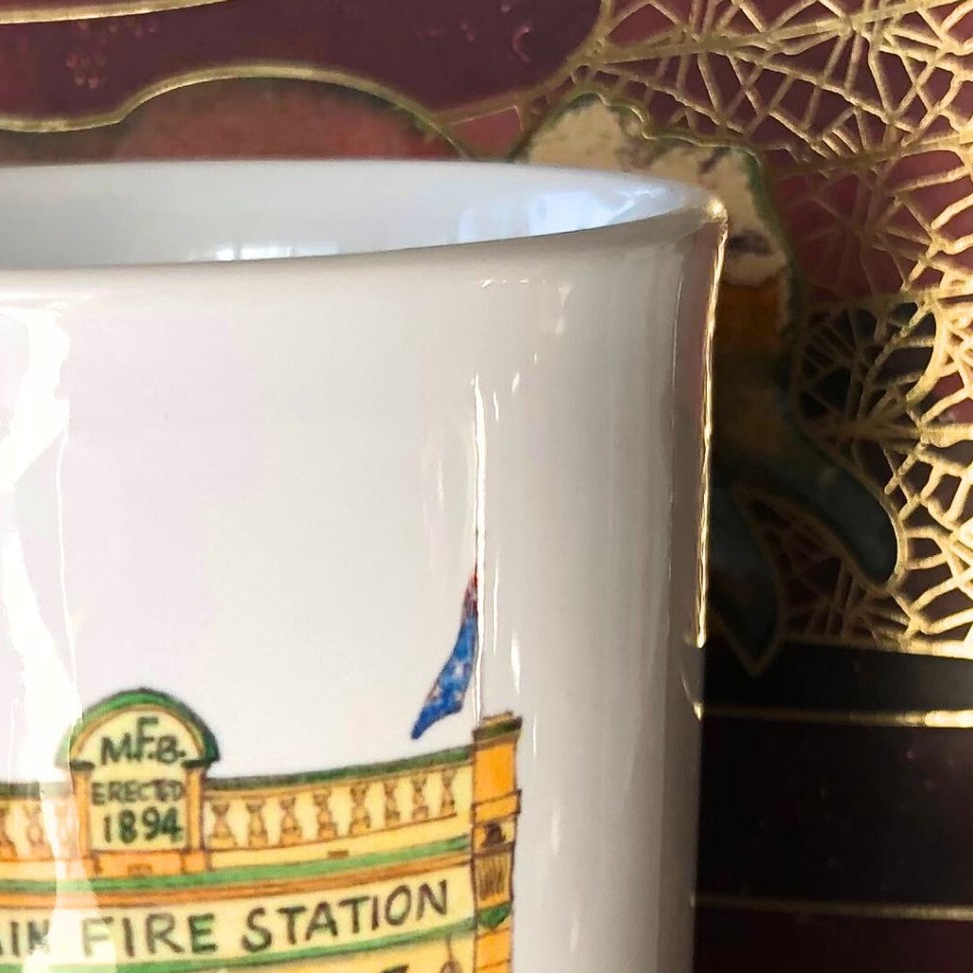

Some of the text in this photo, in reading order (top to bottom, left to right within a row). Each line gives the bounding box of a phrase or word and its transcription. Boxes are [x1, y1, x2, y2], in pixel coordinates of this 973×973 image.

[102, 806, 183, 844] 1894
[82, 912, 218, 958] FIRE
[241, 879, 448, 953] STATION
